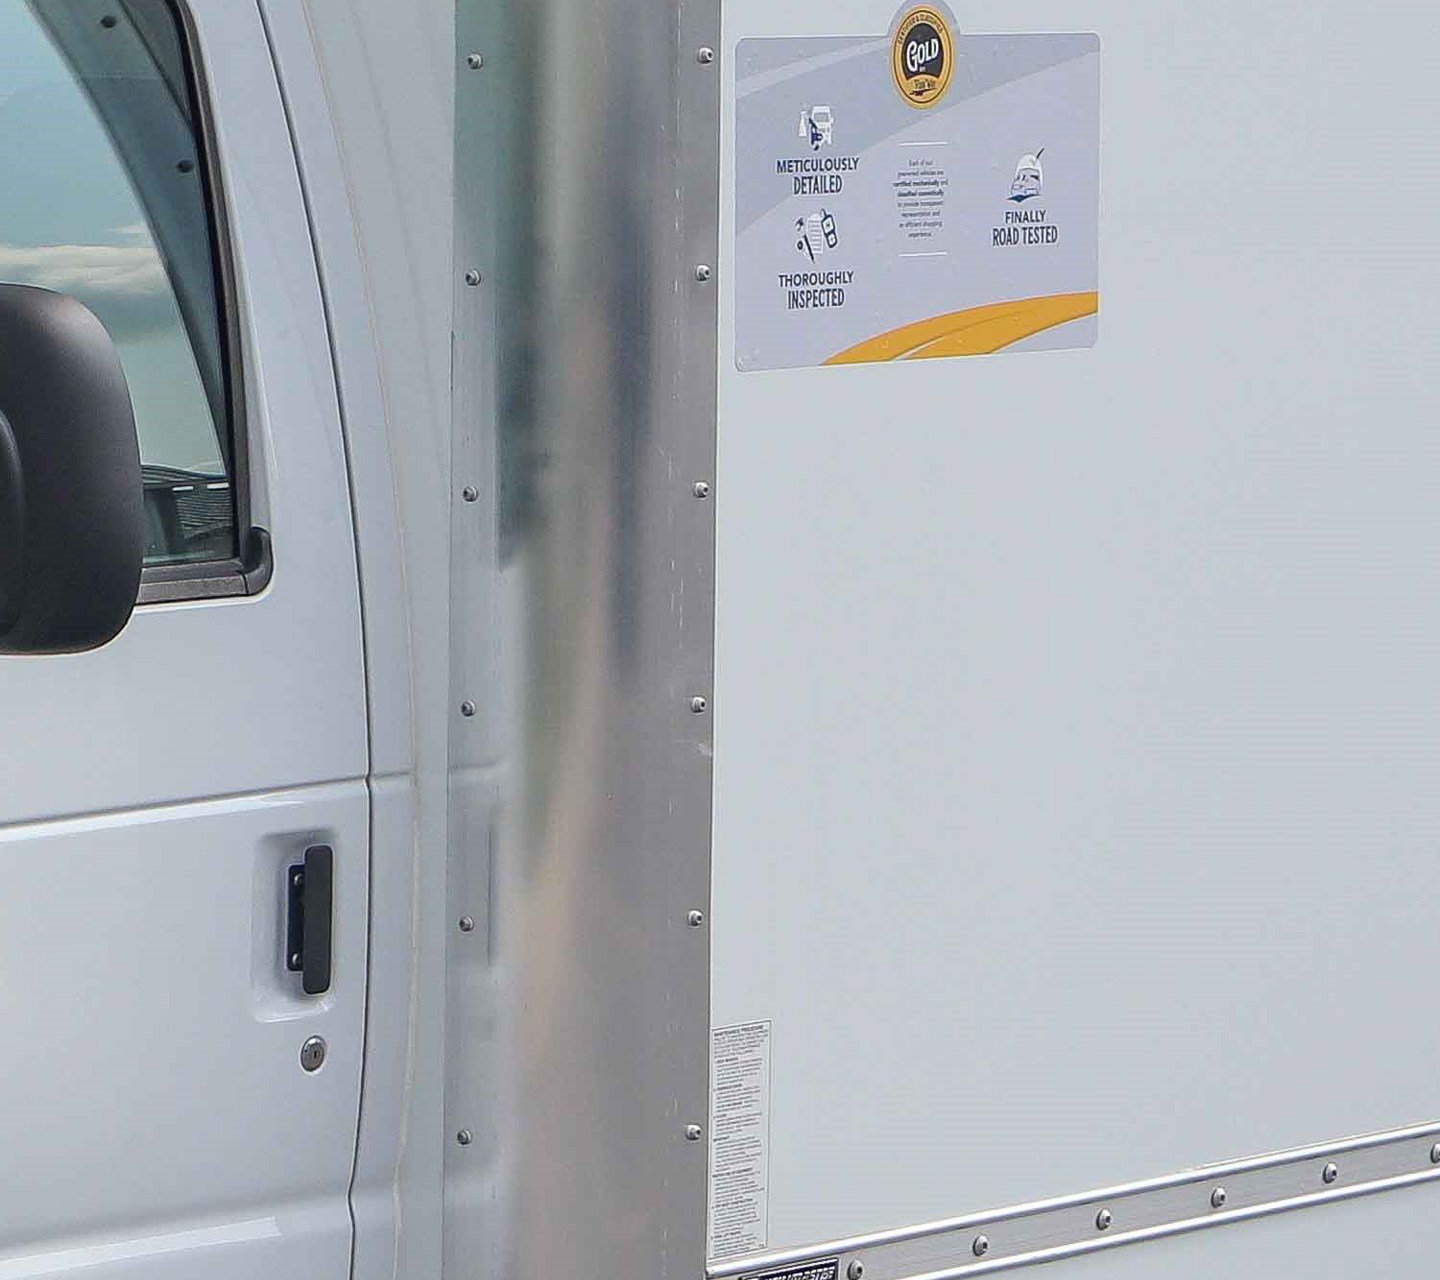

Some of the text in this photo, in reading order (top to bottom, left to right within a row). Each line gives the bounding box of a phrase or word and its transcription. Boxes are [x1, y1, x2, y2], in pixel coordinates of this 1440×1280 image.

[776, 156, 860, 175] METICULOUSLY
[793, 175, 843, 196] DETAILED
[1005, 209, 1047, 225] FINALLY
[992, 226, 1059, 248] ROAD TESTED
[778, 270, 855, 288] THOROUGHLY
[787, 288, 845, 310] INSPECTED
